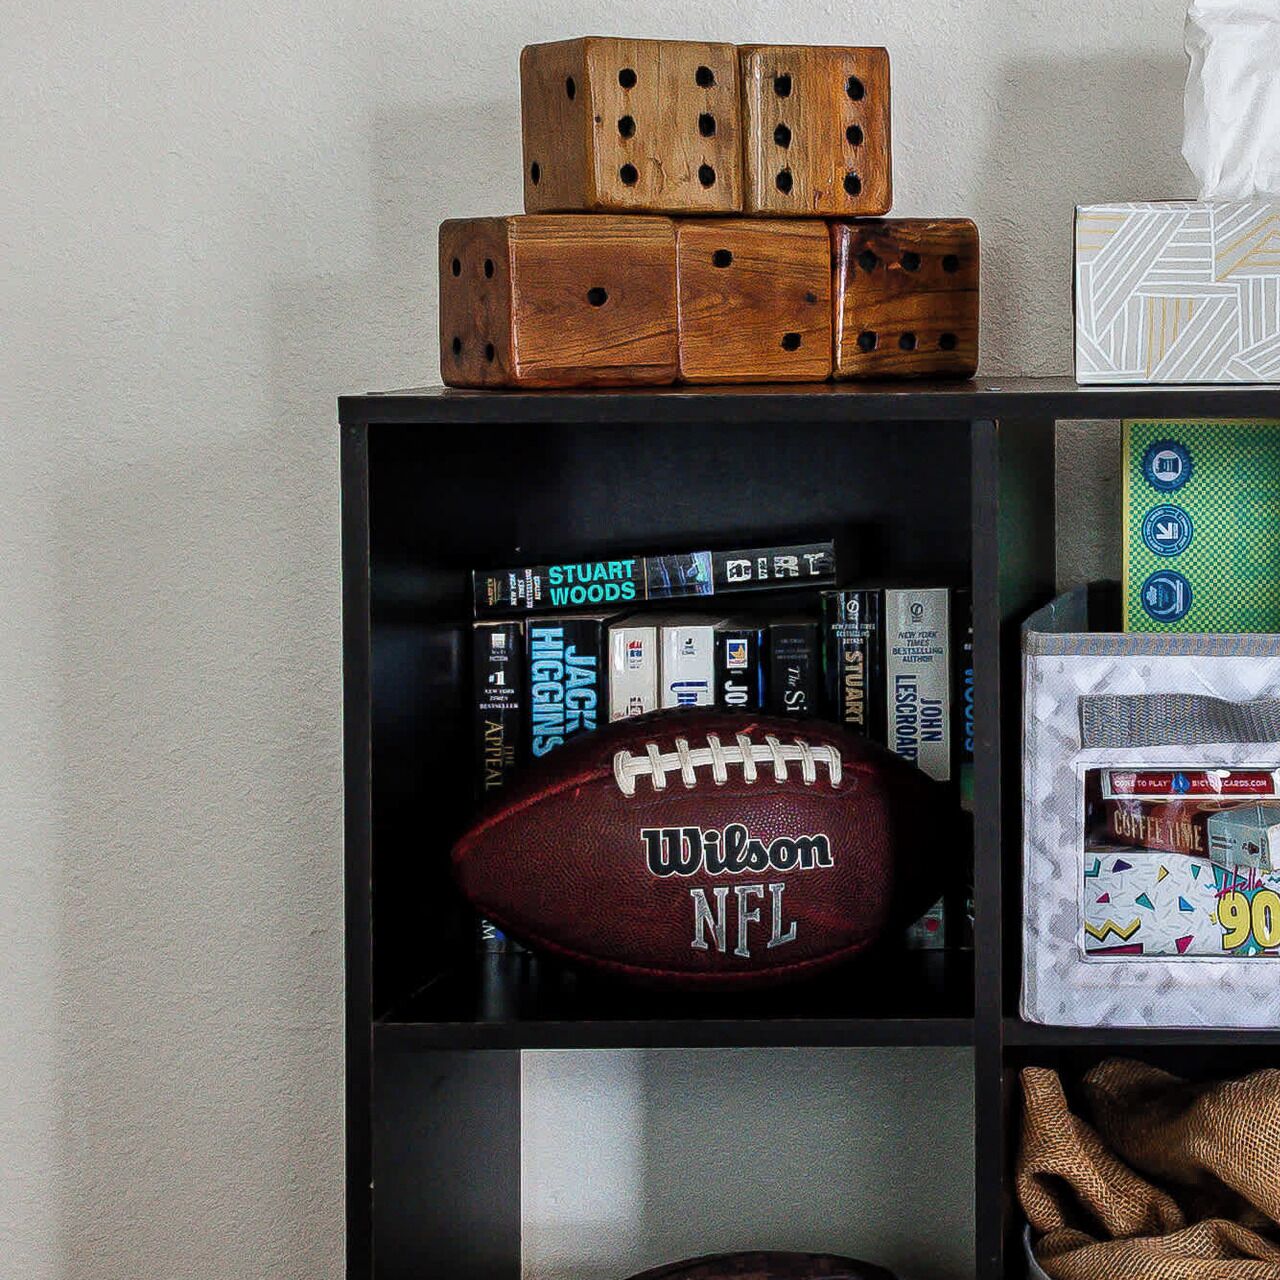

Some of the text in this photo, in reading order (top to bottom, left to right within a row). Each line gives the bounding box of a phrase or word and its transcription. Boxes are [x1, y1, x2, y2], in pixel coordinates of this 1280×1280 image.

[549, 559, 637, 586] STUART
[726, 552, 825, 582] DIRT
[550, 581, 637, 606] WOODS
[898, 631, 915, 639] NEW
[906, 639, 930, 647] TIMES
[892, 647, 944, 655] BESTSELLING
[902, 655, 933, 663] AUTHOR
[488, 671, 506, 686] #1
[530, 627, 565, 759] HIGGINS
[565, 644, 598, 734] JACK
[845, 650, 865, 726] STUART
[921, 698, 943, 743] JOHN
[484, 719, 505, 792] APPEAL
[1113, 809, 1164, 842] COFFEE
[640, 823, 833, 877] Wilson
[690, 882, 798, 959] NFL
